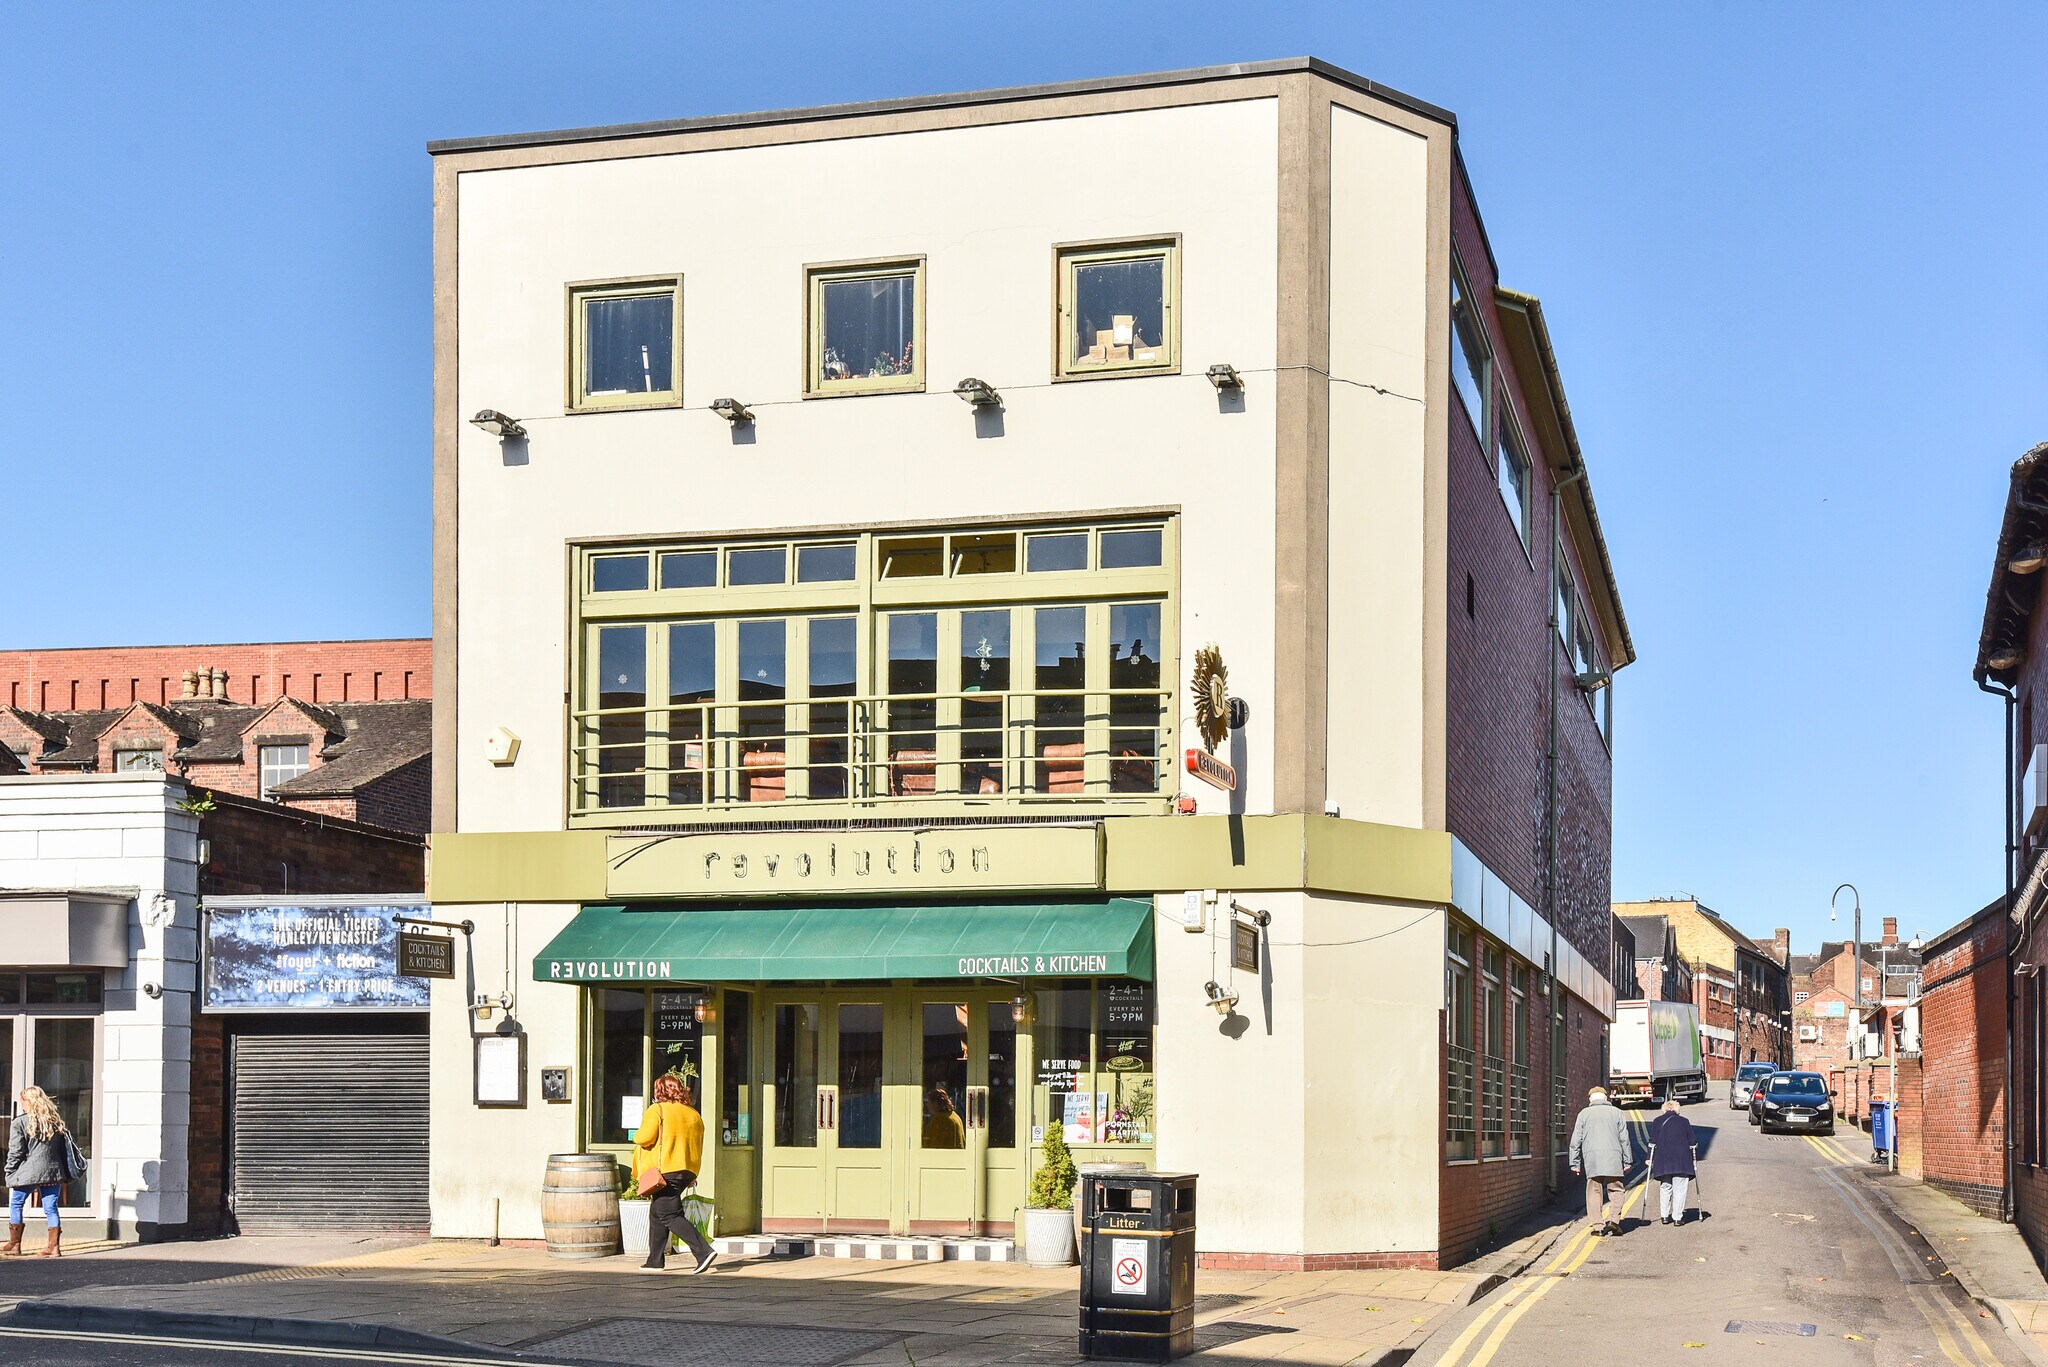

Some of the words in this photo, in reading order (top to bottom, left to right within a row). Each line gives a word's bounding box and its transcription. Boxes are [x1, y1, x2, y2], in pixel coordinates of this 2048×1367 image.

[273, 917, 293, 931] THE
[295, 917, 340, 931] OFFICIAL
[344, 917, 380, 931] TICKET
[273, 931, 379, 945] HANLEY/NEWCASTLE
[408, 942, 445, 956] COCKTAILS
[282, 954, 319, 972] foyer
[336, 953, 376, 969] fiction
[408, 956, 415, 967] &
[416, 957, 445, 970] KITCHEN
[958, 956, 1030, 975] COCKTAILS
[1034, 955, 1046, 973] &
[1049, 955, 1107, 973] KITCHEN
[257, 980, 264, 993] 2
[267, 979, 306, 994] VENUES
[328, 979, 360, 994] ENTRY
[363, 979, 395, 994] PRICE
[1109, 985, 1144, 995] 2-4-1
[661, 995, 692, 1005] 2-4-1
[1109, 1012, 1144, 1022] 5-9PM
[660, 1021, 692, 1030] 5-9PM
[1041, 1059, 1050, 1070] WE
[1051, 1059, 1067, 1070] SERVE
[1067, 1059, 1082, 1070] FOOD
[1109, 1217, 1141, 1229] Litter
